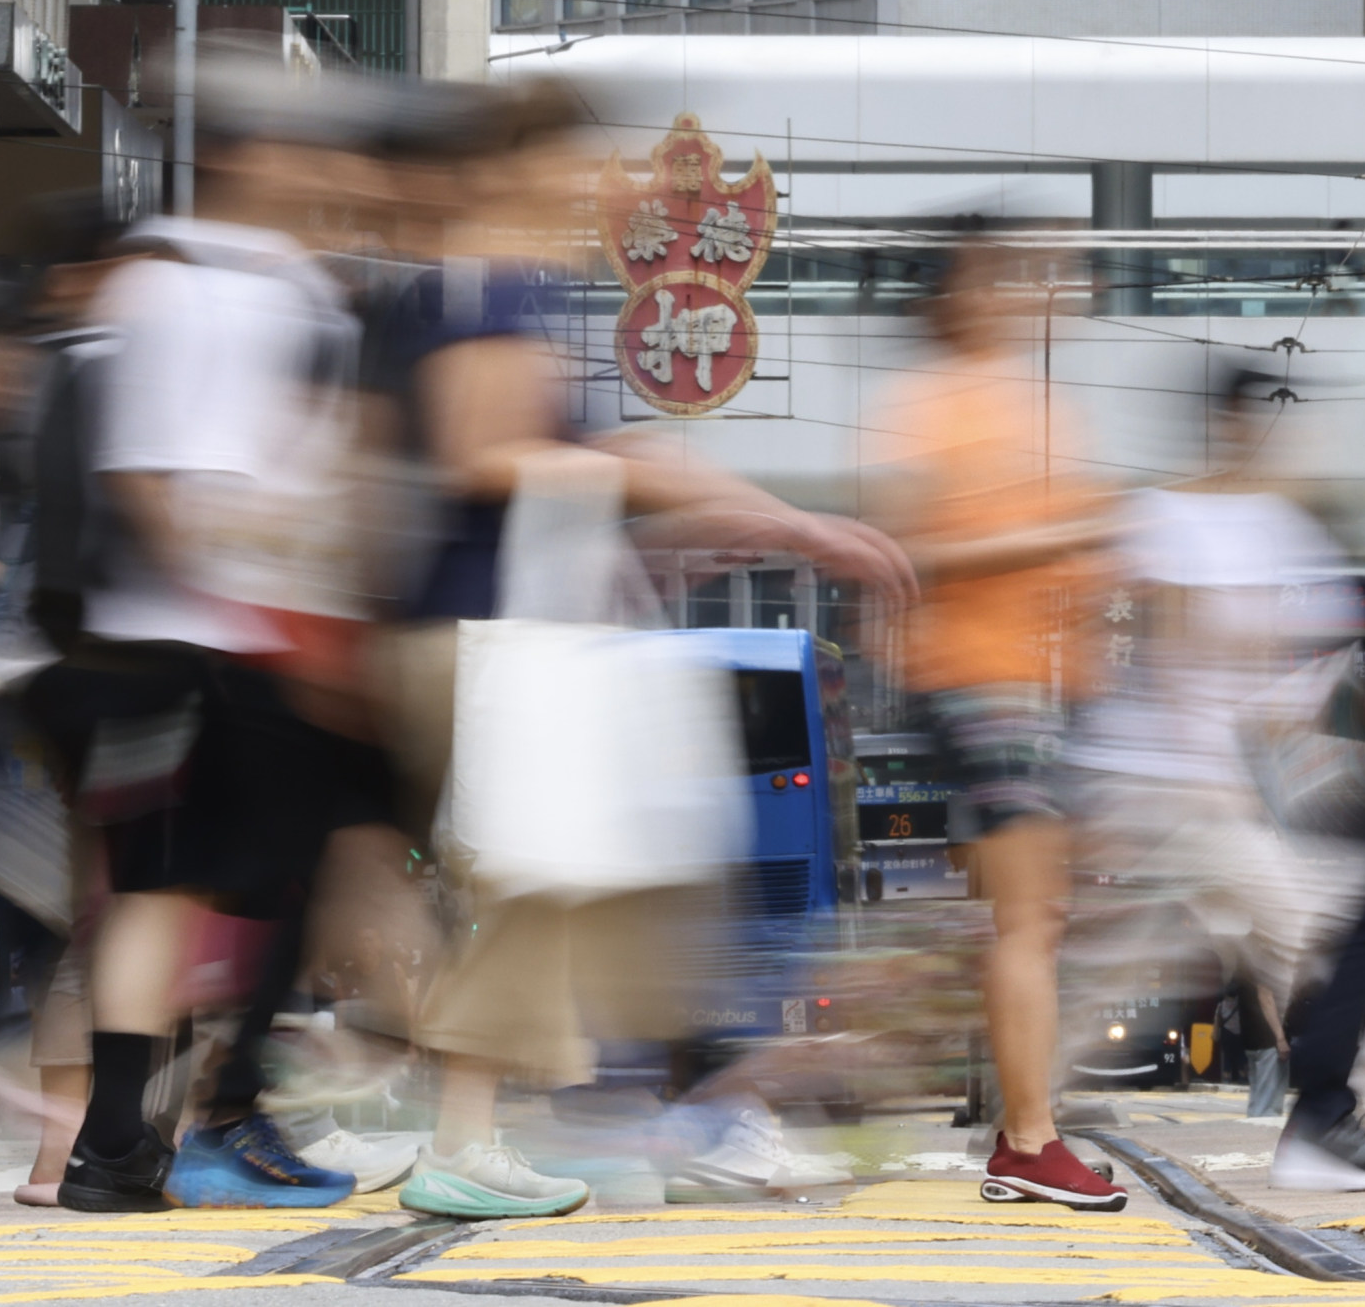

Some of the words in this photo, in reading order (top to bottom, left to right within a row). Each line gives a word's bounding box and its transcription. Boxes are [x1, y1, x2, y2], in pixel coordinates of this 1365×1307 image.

[636, 289, 738, 393] 押
[898, 790, 929, 803] 5562
[888, 814, 912, 837] 26
[691, 1008, 758, 1026] Citybus
[1163, 1052, 1176, 1064] 92
